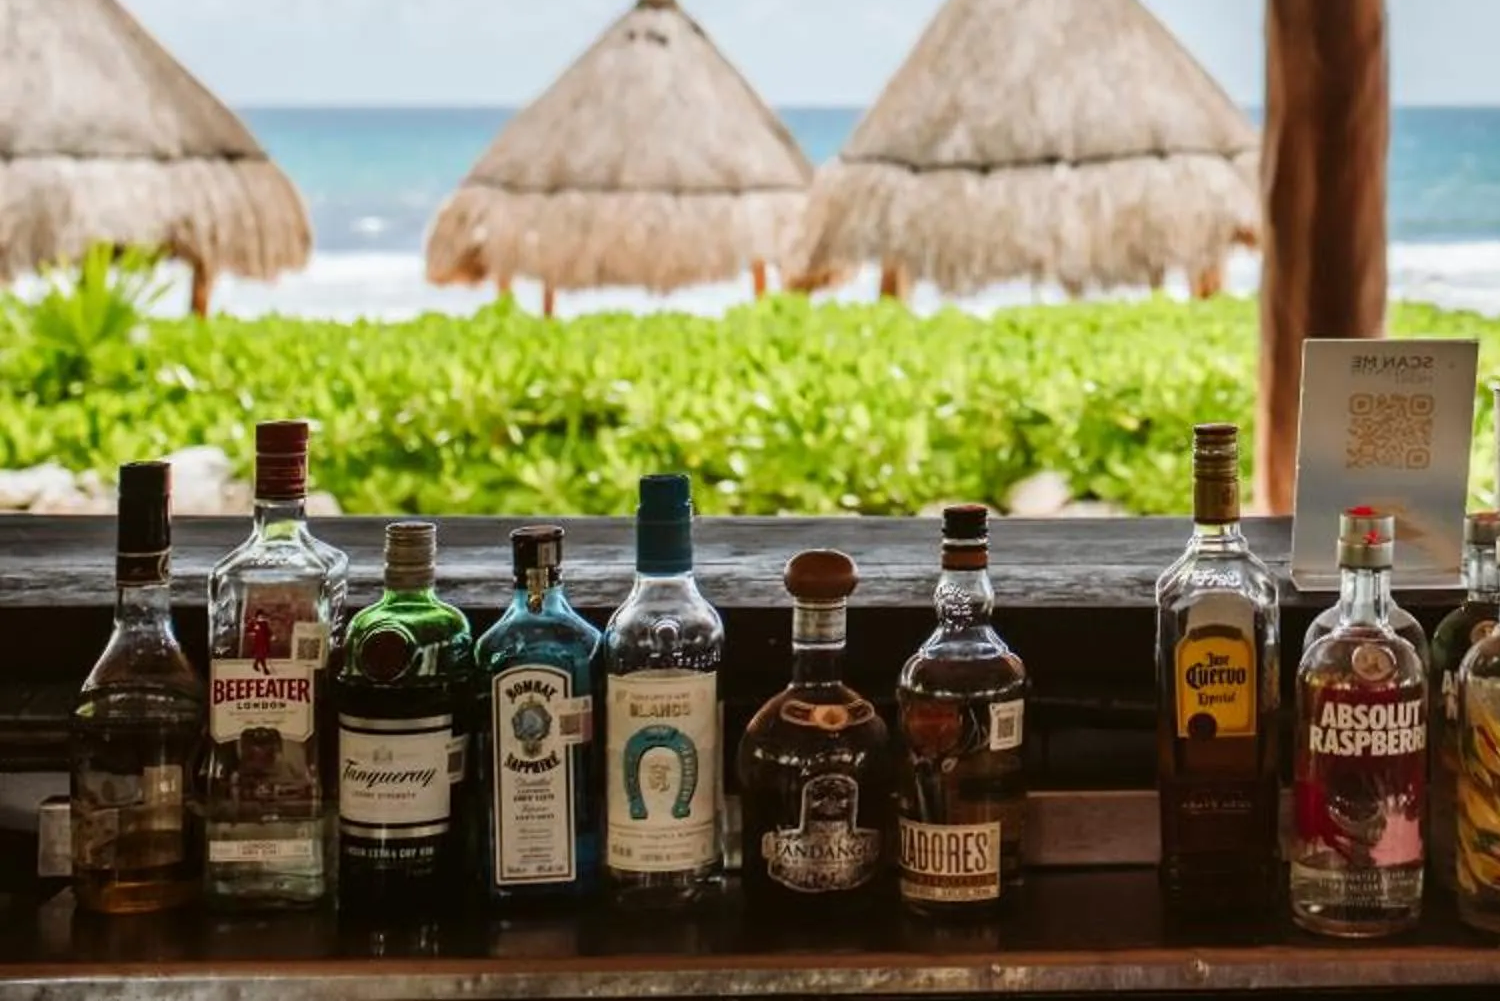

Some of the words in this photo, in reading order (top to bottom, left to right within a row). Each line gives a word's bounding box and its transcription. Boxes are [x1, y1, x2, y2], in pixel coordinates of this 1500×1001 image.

[1185, 662, 1247, 690] Cuervo
[213, 678, 311, 706] BEEFEATER
[236, 702, 287, 710] LONDON
[505, 679, 559, 705] BOMBAY
[1320, 699, 1421, 730] ABSOLUT
[342, 758, 438, 789] Tanqueray
[504, 750, 561, 774] SAPPHIRE
